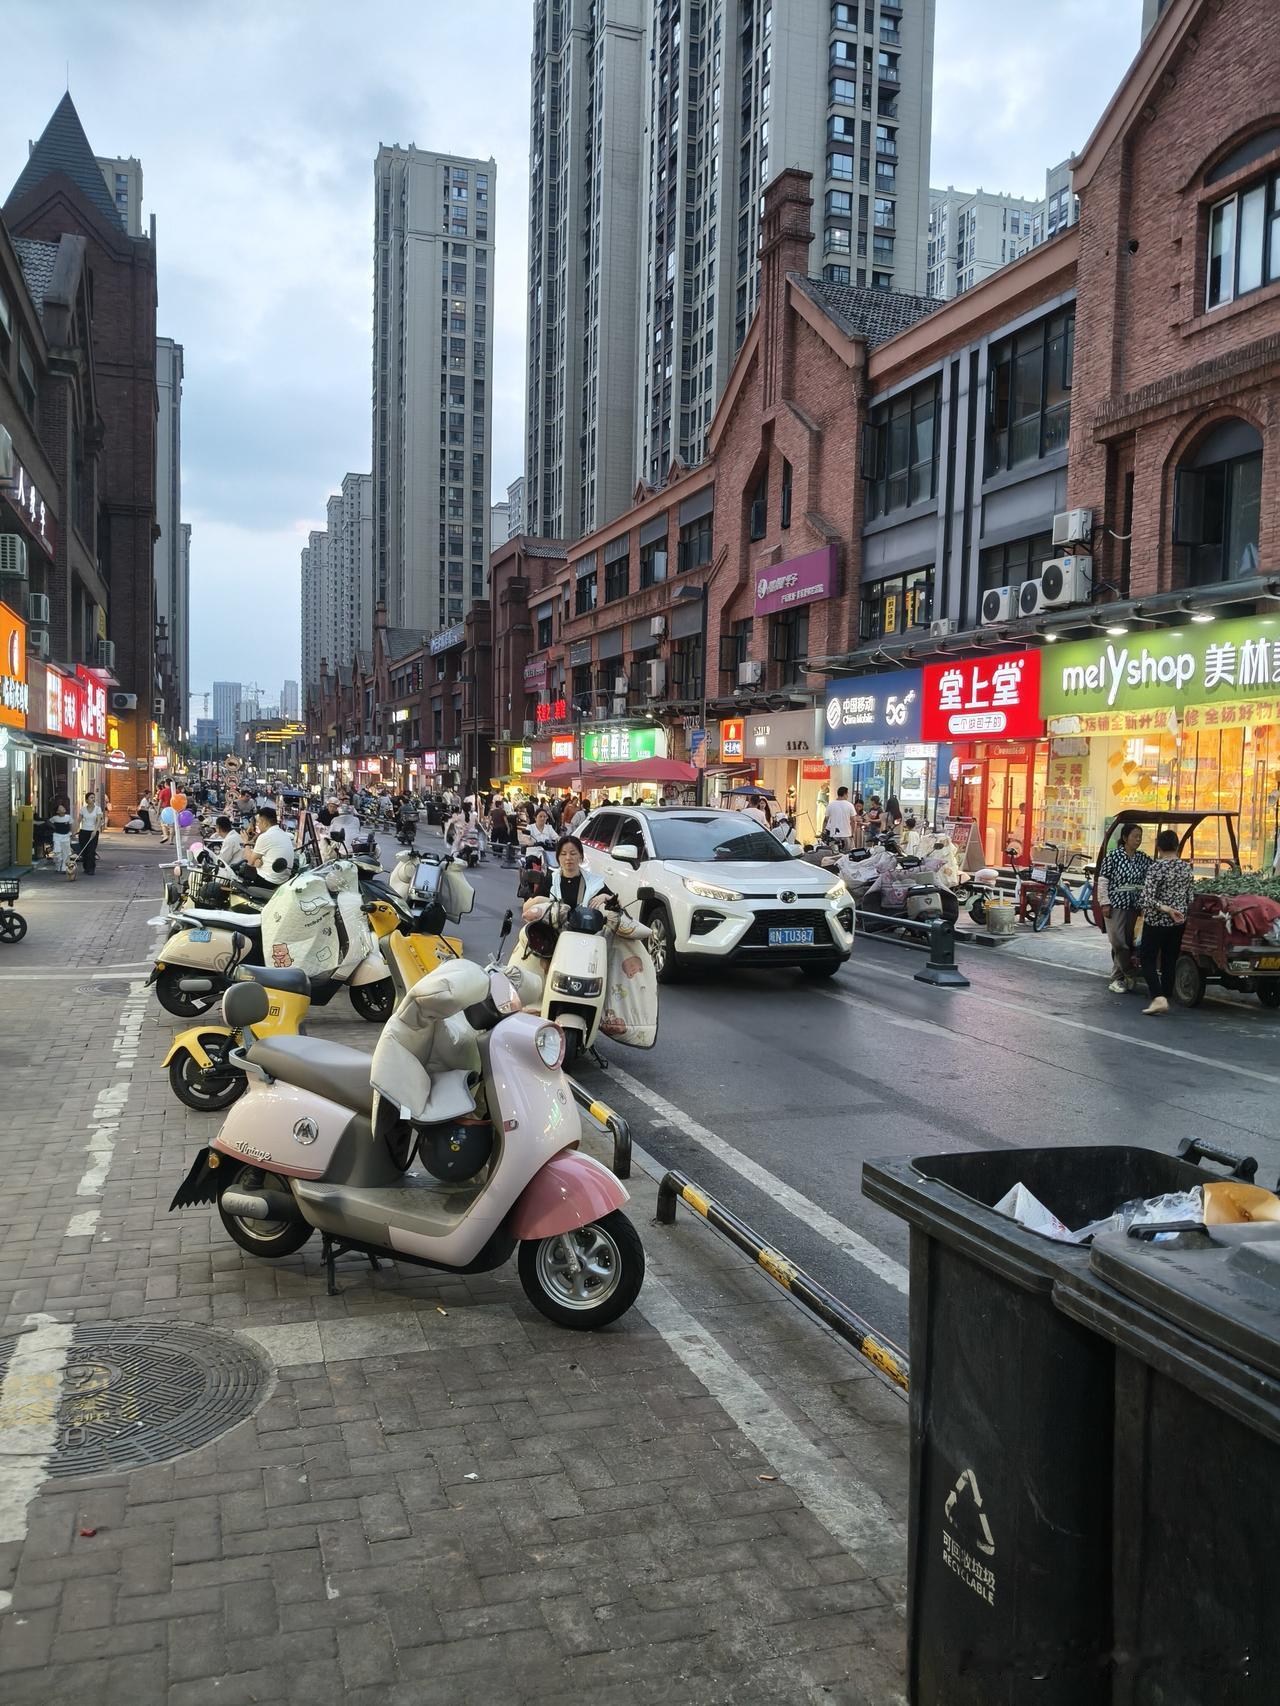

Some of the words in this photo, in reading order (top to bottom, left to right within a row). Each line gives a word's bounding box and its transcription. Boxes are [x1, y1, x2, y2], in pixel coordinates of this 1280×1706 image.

[938, 661, 1021, 711] 堂上堂
[1204, 637, 1280, 689] 美林
[843, 695, 875, 713] 中国移动
[1084, 709, 1167, 732] 店铺全新升级
[1205, 702, 1280, 725] 全场好物
[942, 1529, 996, 1592] 可回收垃圾
[942, 1549, 995, 1607] RECYCLABLE
